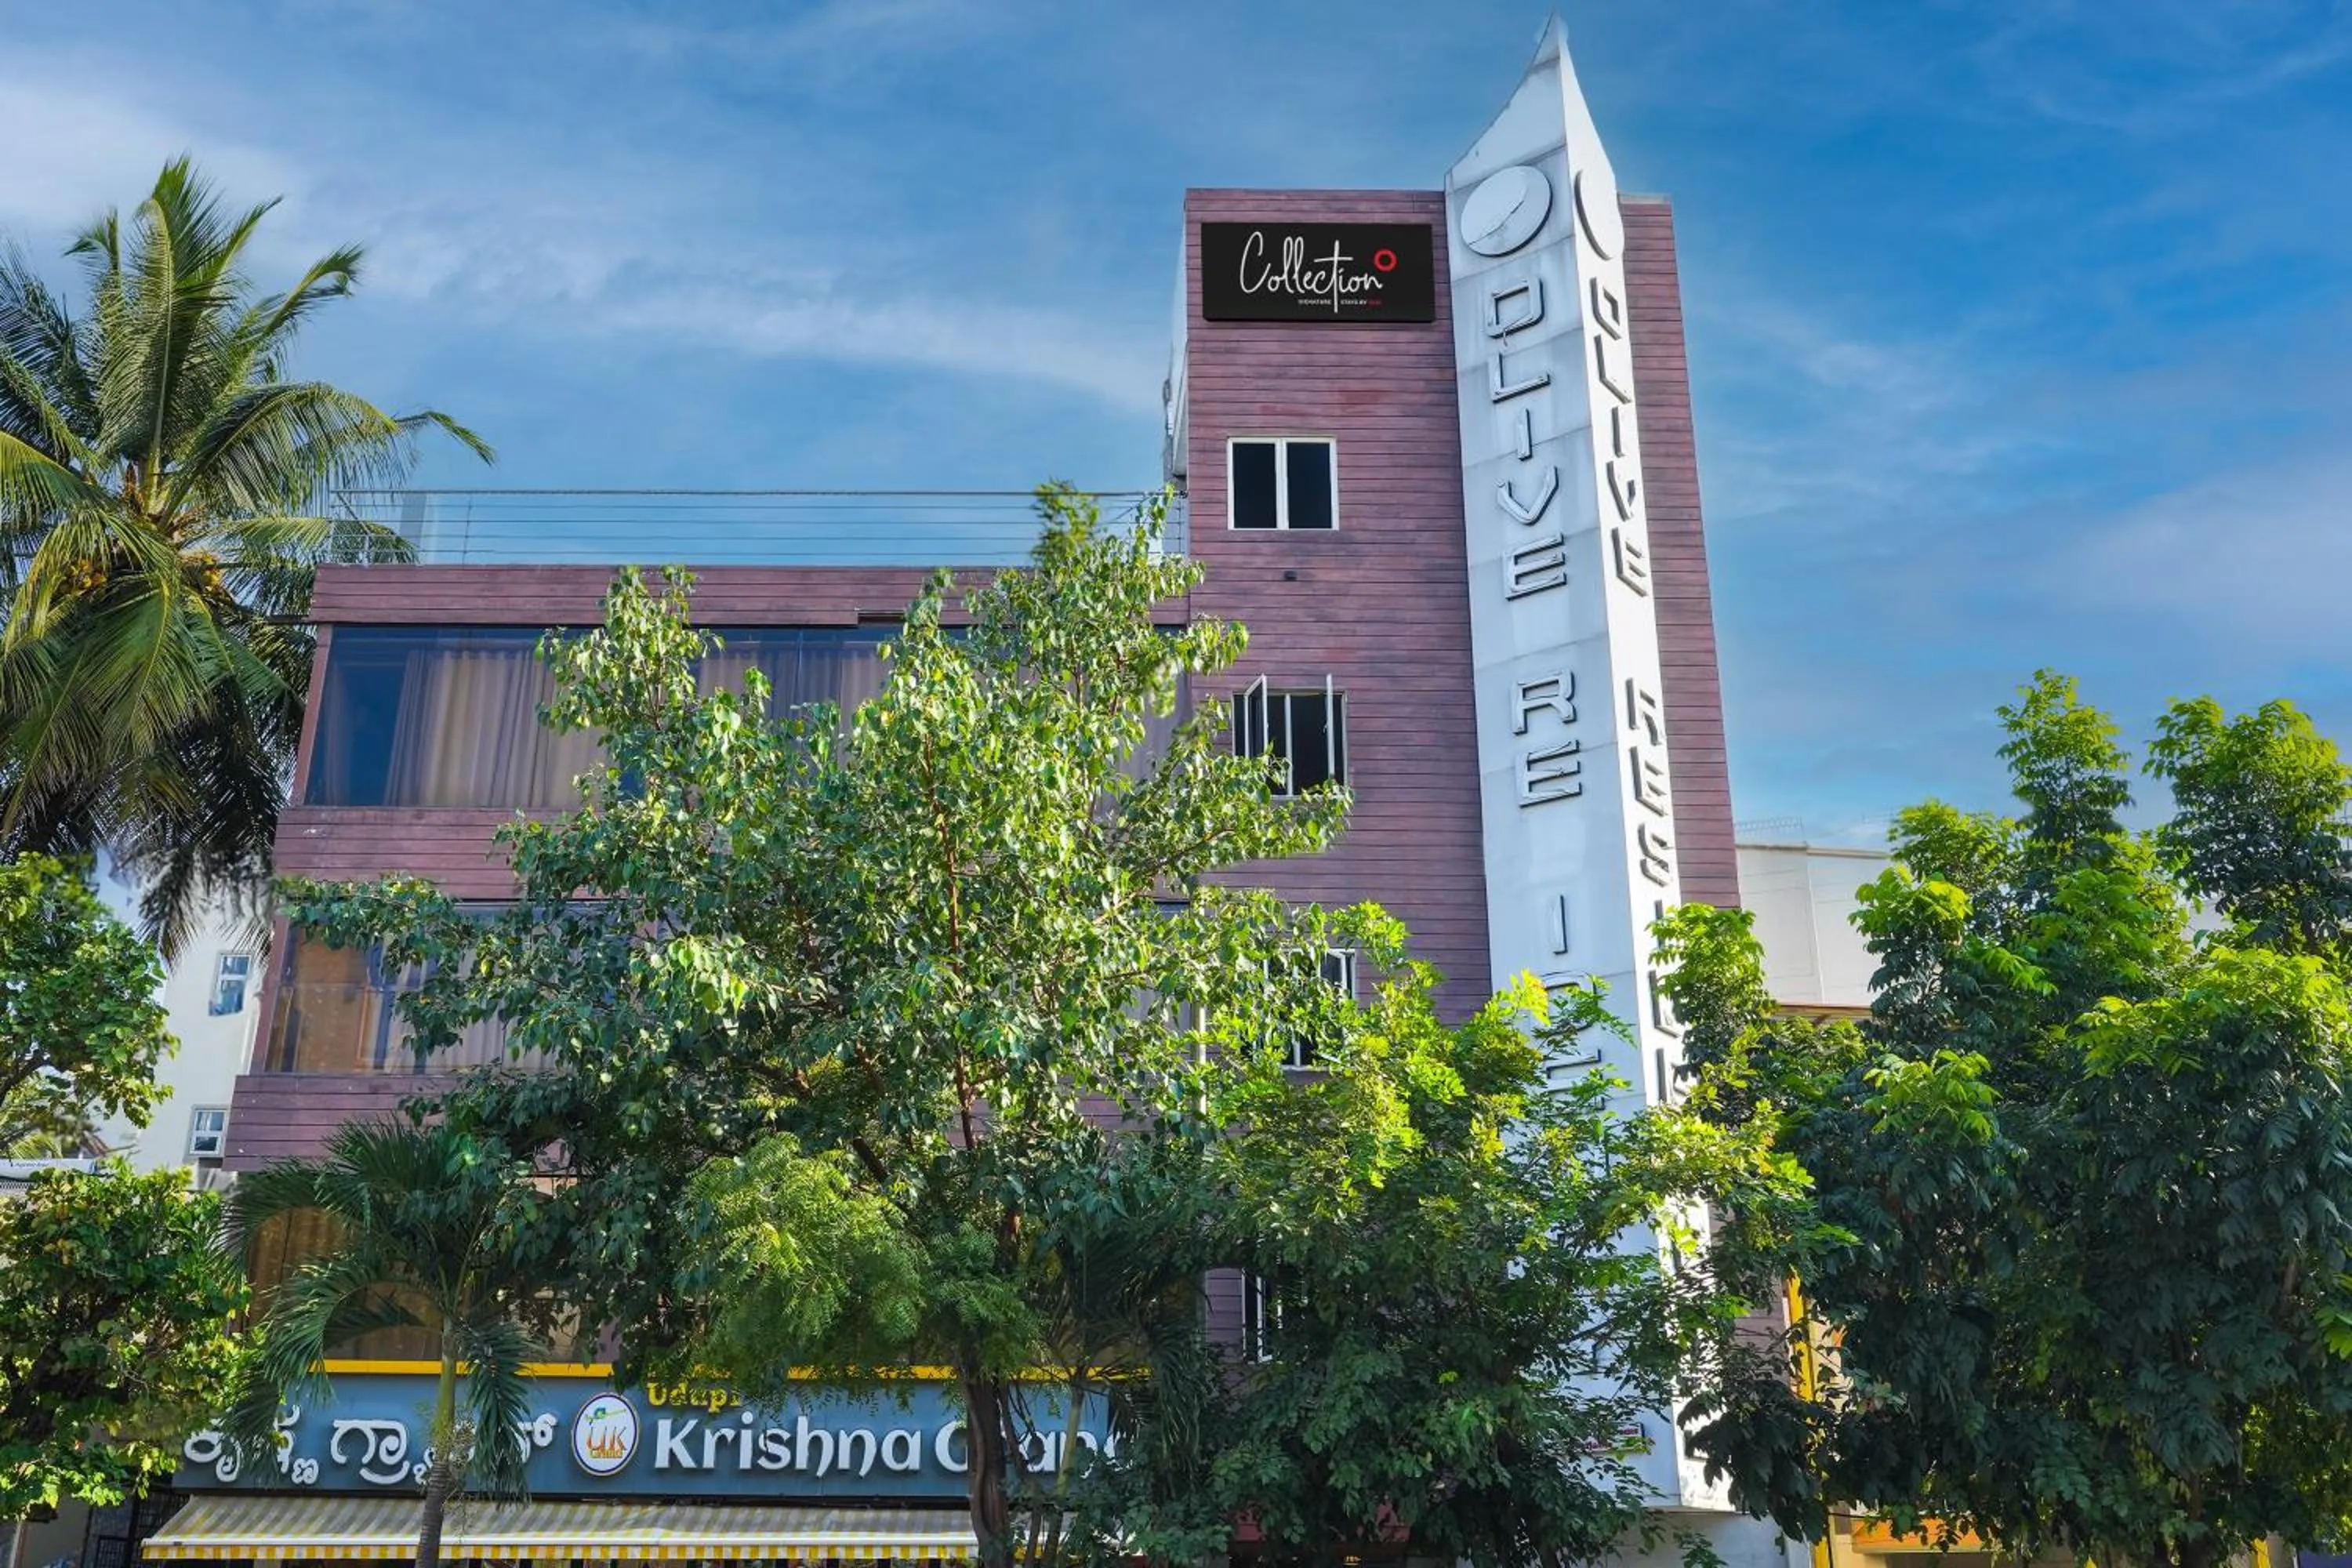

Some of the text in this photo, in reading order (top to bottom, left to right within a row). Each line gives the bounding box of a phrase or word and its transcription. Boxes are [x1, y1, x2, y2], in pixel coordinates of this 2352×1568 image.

[1240, 230, 1383, 313] Collection
[1486, 276, 1568, 601] OLIVE
[1590, 276, 1647, 597] OLIVE
[586, 1425, 627, 1450] UK
[655, 1411, 920, 1477] Krishna
